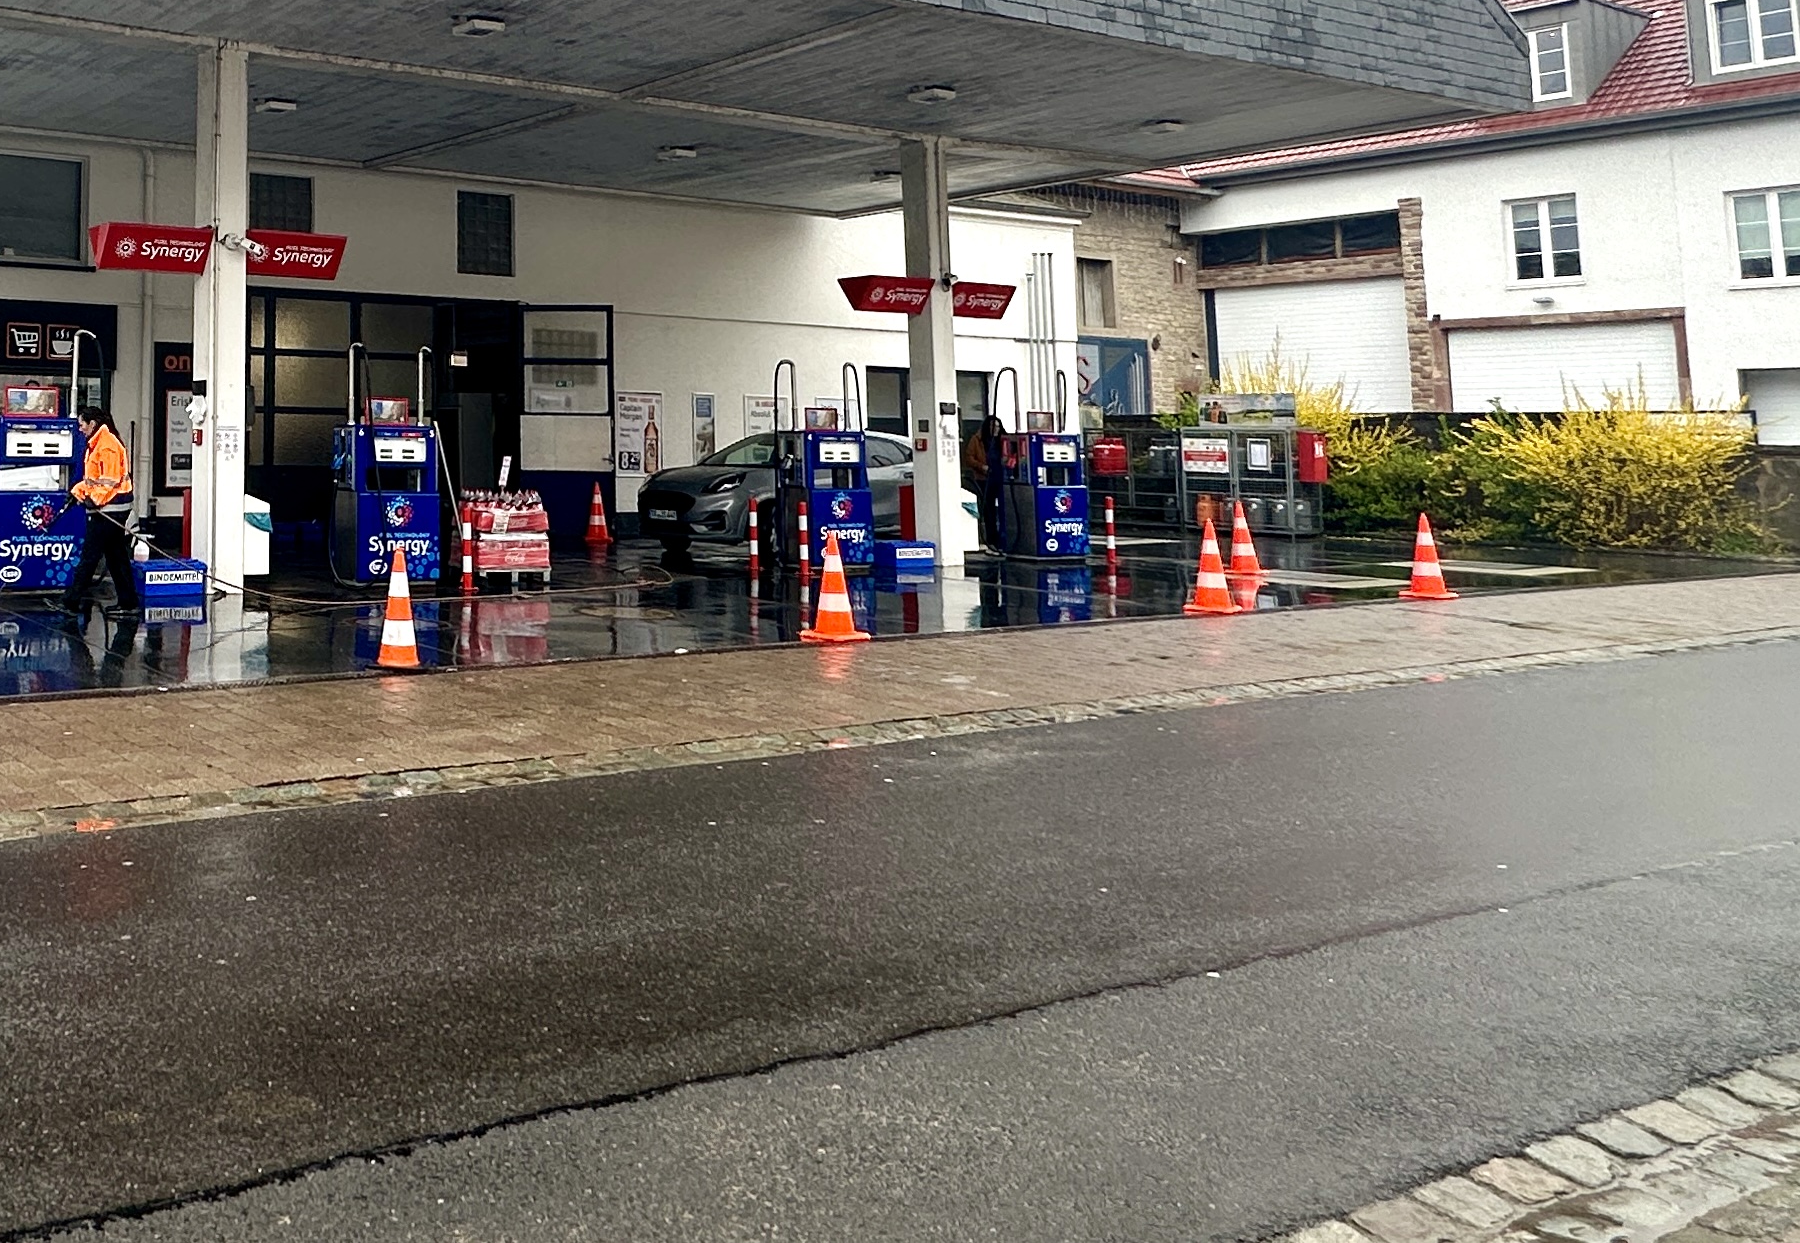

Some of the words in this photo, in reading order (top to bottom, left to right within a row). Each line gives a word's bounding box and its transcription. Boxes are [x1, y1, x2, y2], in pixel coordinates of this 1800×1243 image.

[140, 241, 205, 262] Synergy
[272, 248, 333, 268] Synergy
[884, 289, 927, 306] Synergy
[966, 295, 1005, 311] Synergy
[820, 526, 866, 544] Snergy
[1044, 519, 1084, 537] Synergy
